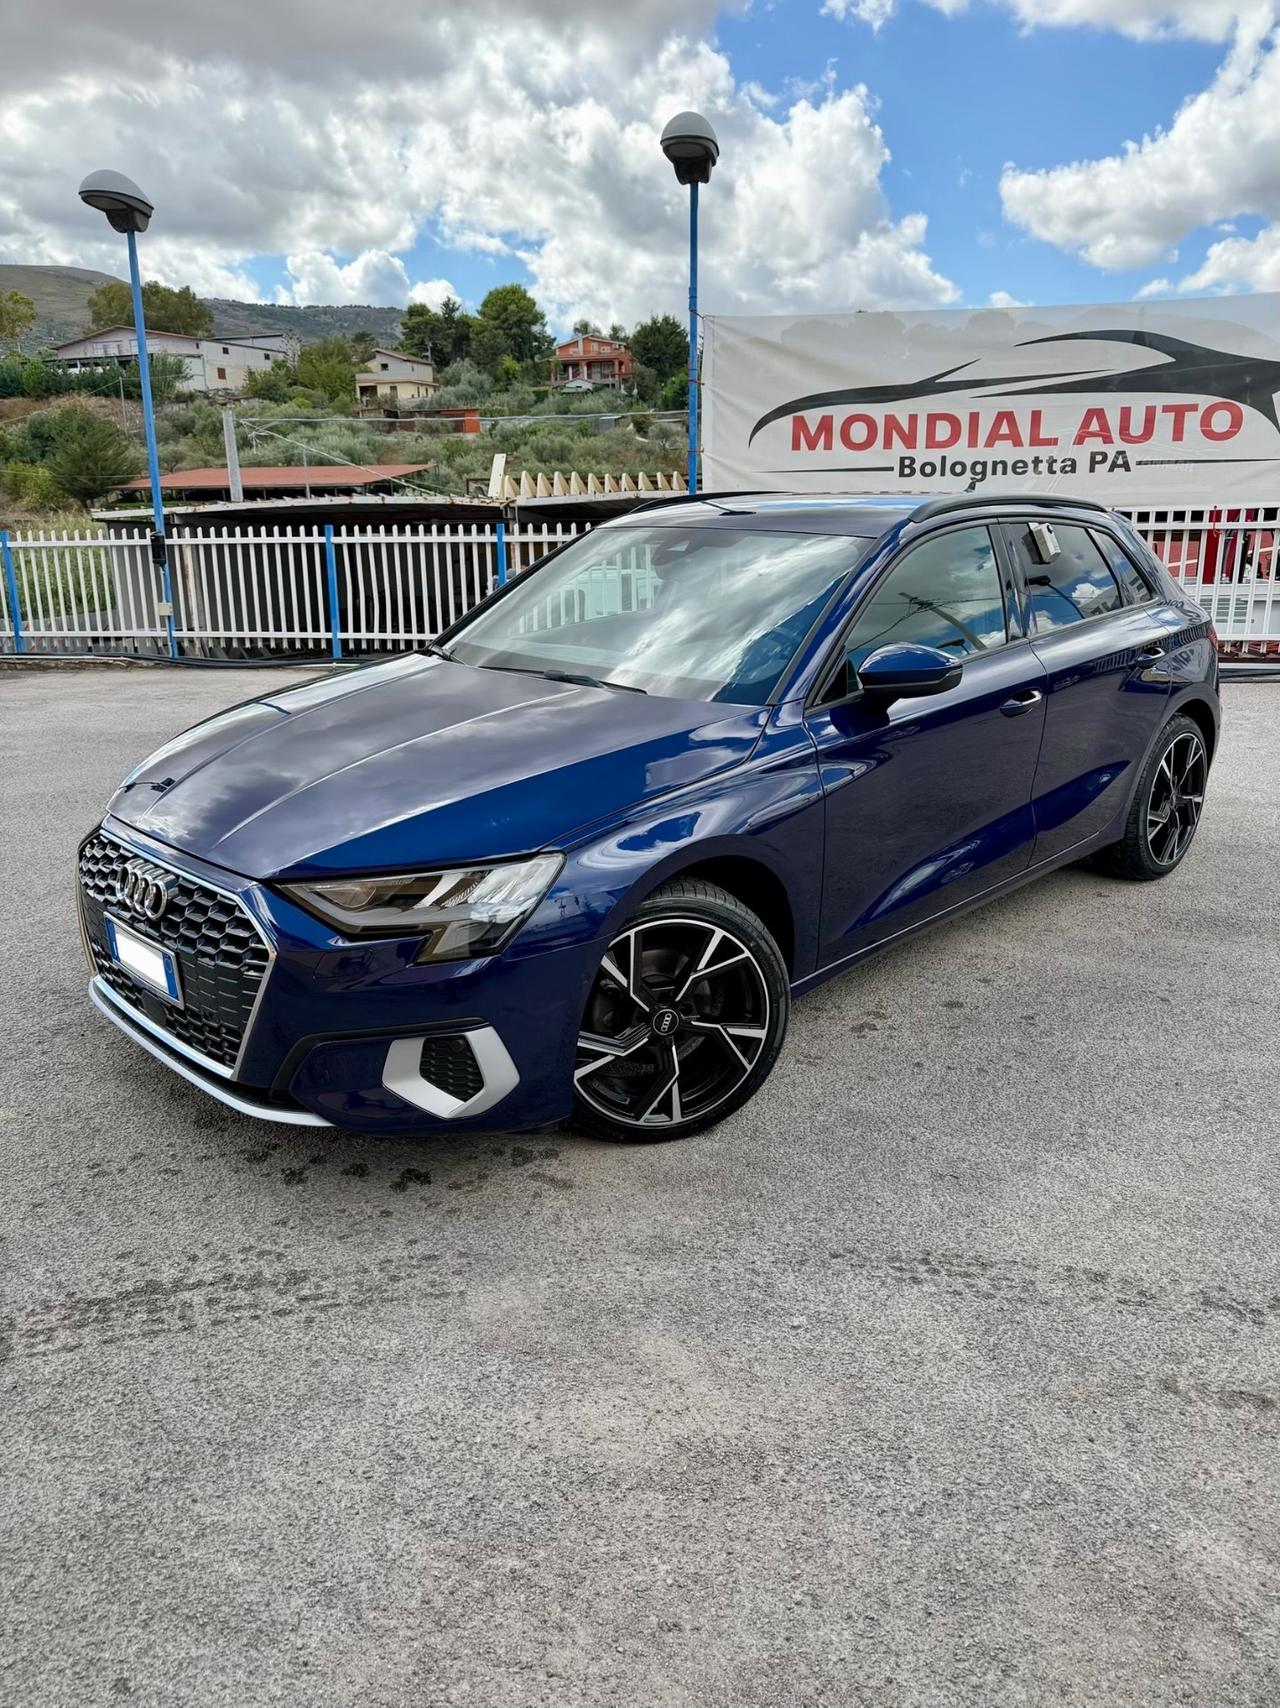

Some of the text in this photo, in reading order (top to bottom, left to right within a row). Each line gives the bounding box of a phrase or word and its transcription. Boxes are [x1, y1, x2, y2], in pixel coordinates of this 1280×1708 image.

[791, 401, 1244, 451] MONDIAL AUTO
[899, 455, 1077, 482] Bolognetta
[1089, 450, 1131, 473] PA
